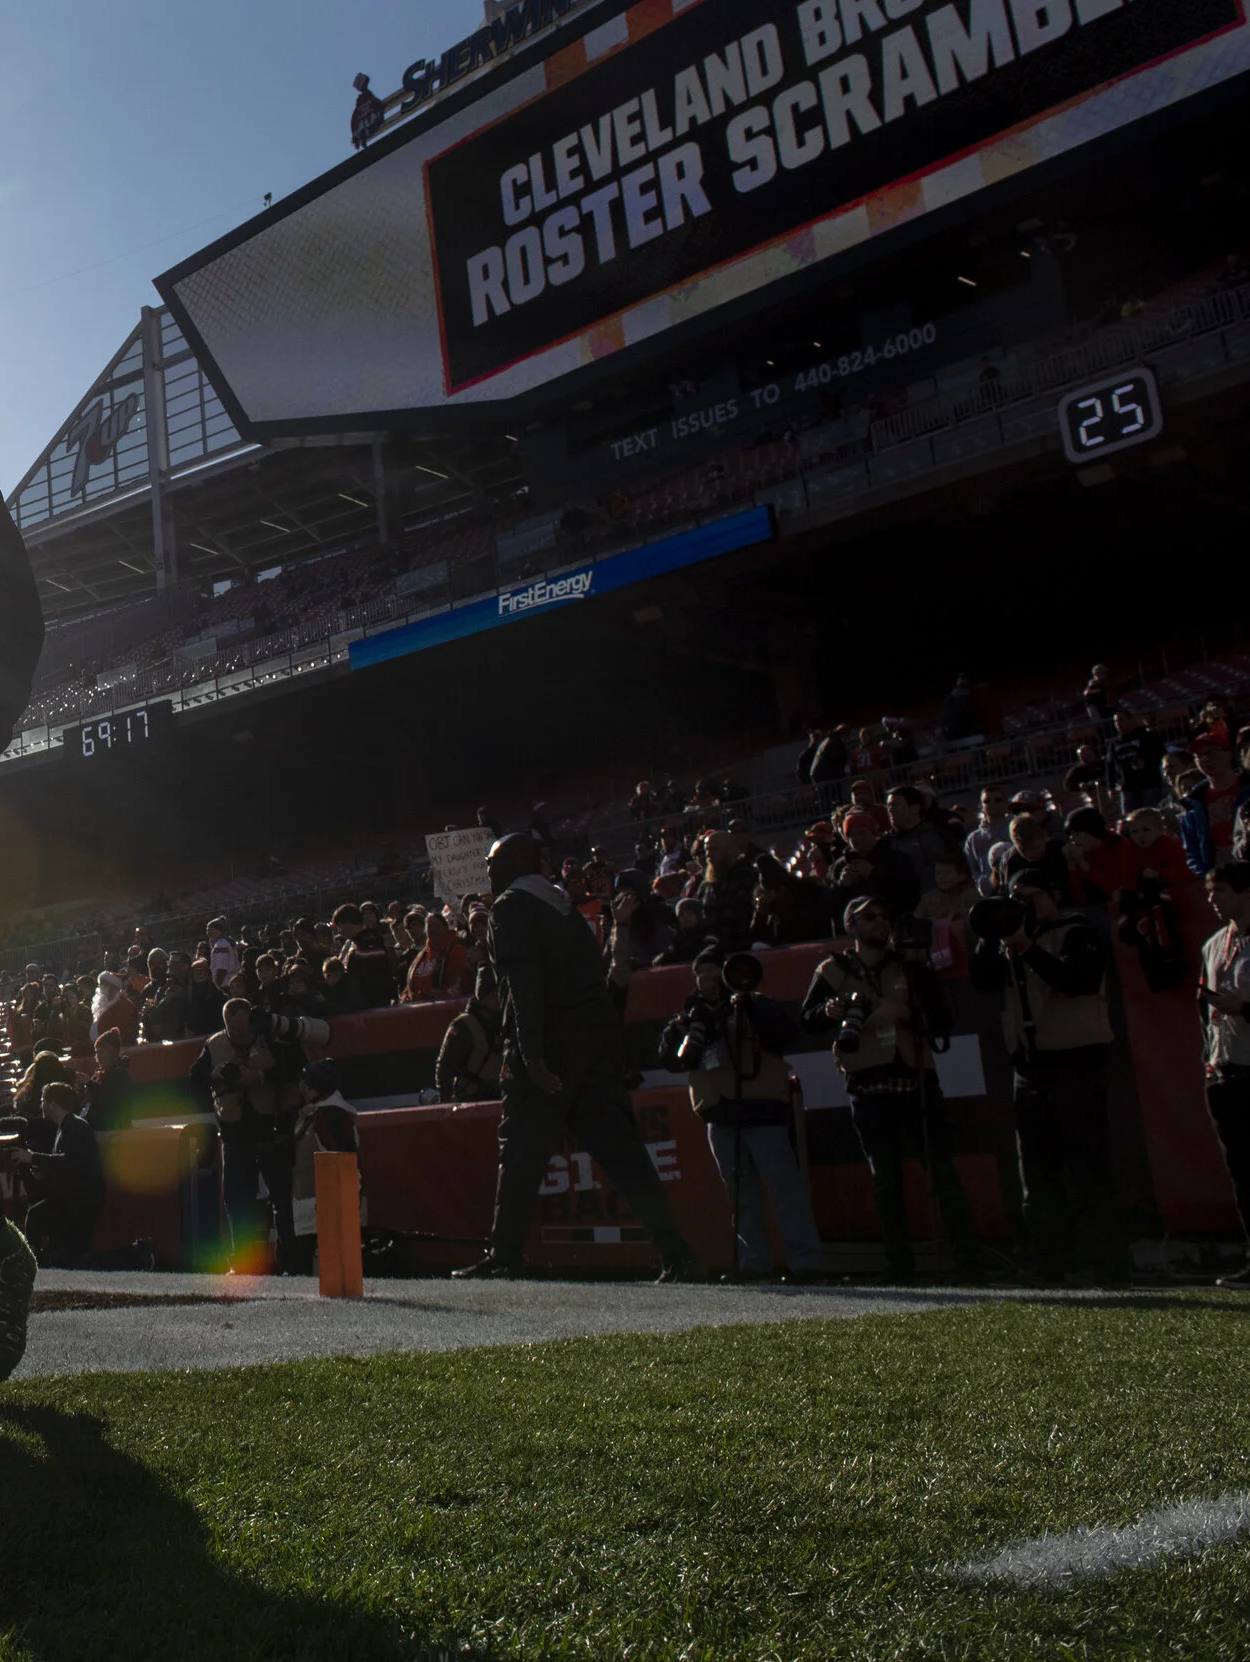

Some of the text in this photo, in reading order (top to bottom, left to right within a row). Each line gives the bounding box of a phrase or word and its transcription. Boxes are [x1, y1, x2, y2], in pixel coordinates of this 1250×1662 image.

[500, 22, 784, 227] CLEVELAND
[466, 141, 712, 327] ROSTER
[610, 323, 937, 460] TEXT ISSUES TO 440-824-6000
[1077, 384, 1144, 447] 25
[498, 570, 594, 616] FirstEnergy
[82, 711, 149, 756] 69:17
[429, 834, 450, 851] OBJ
